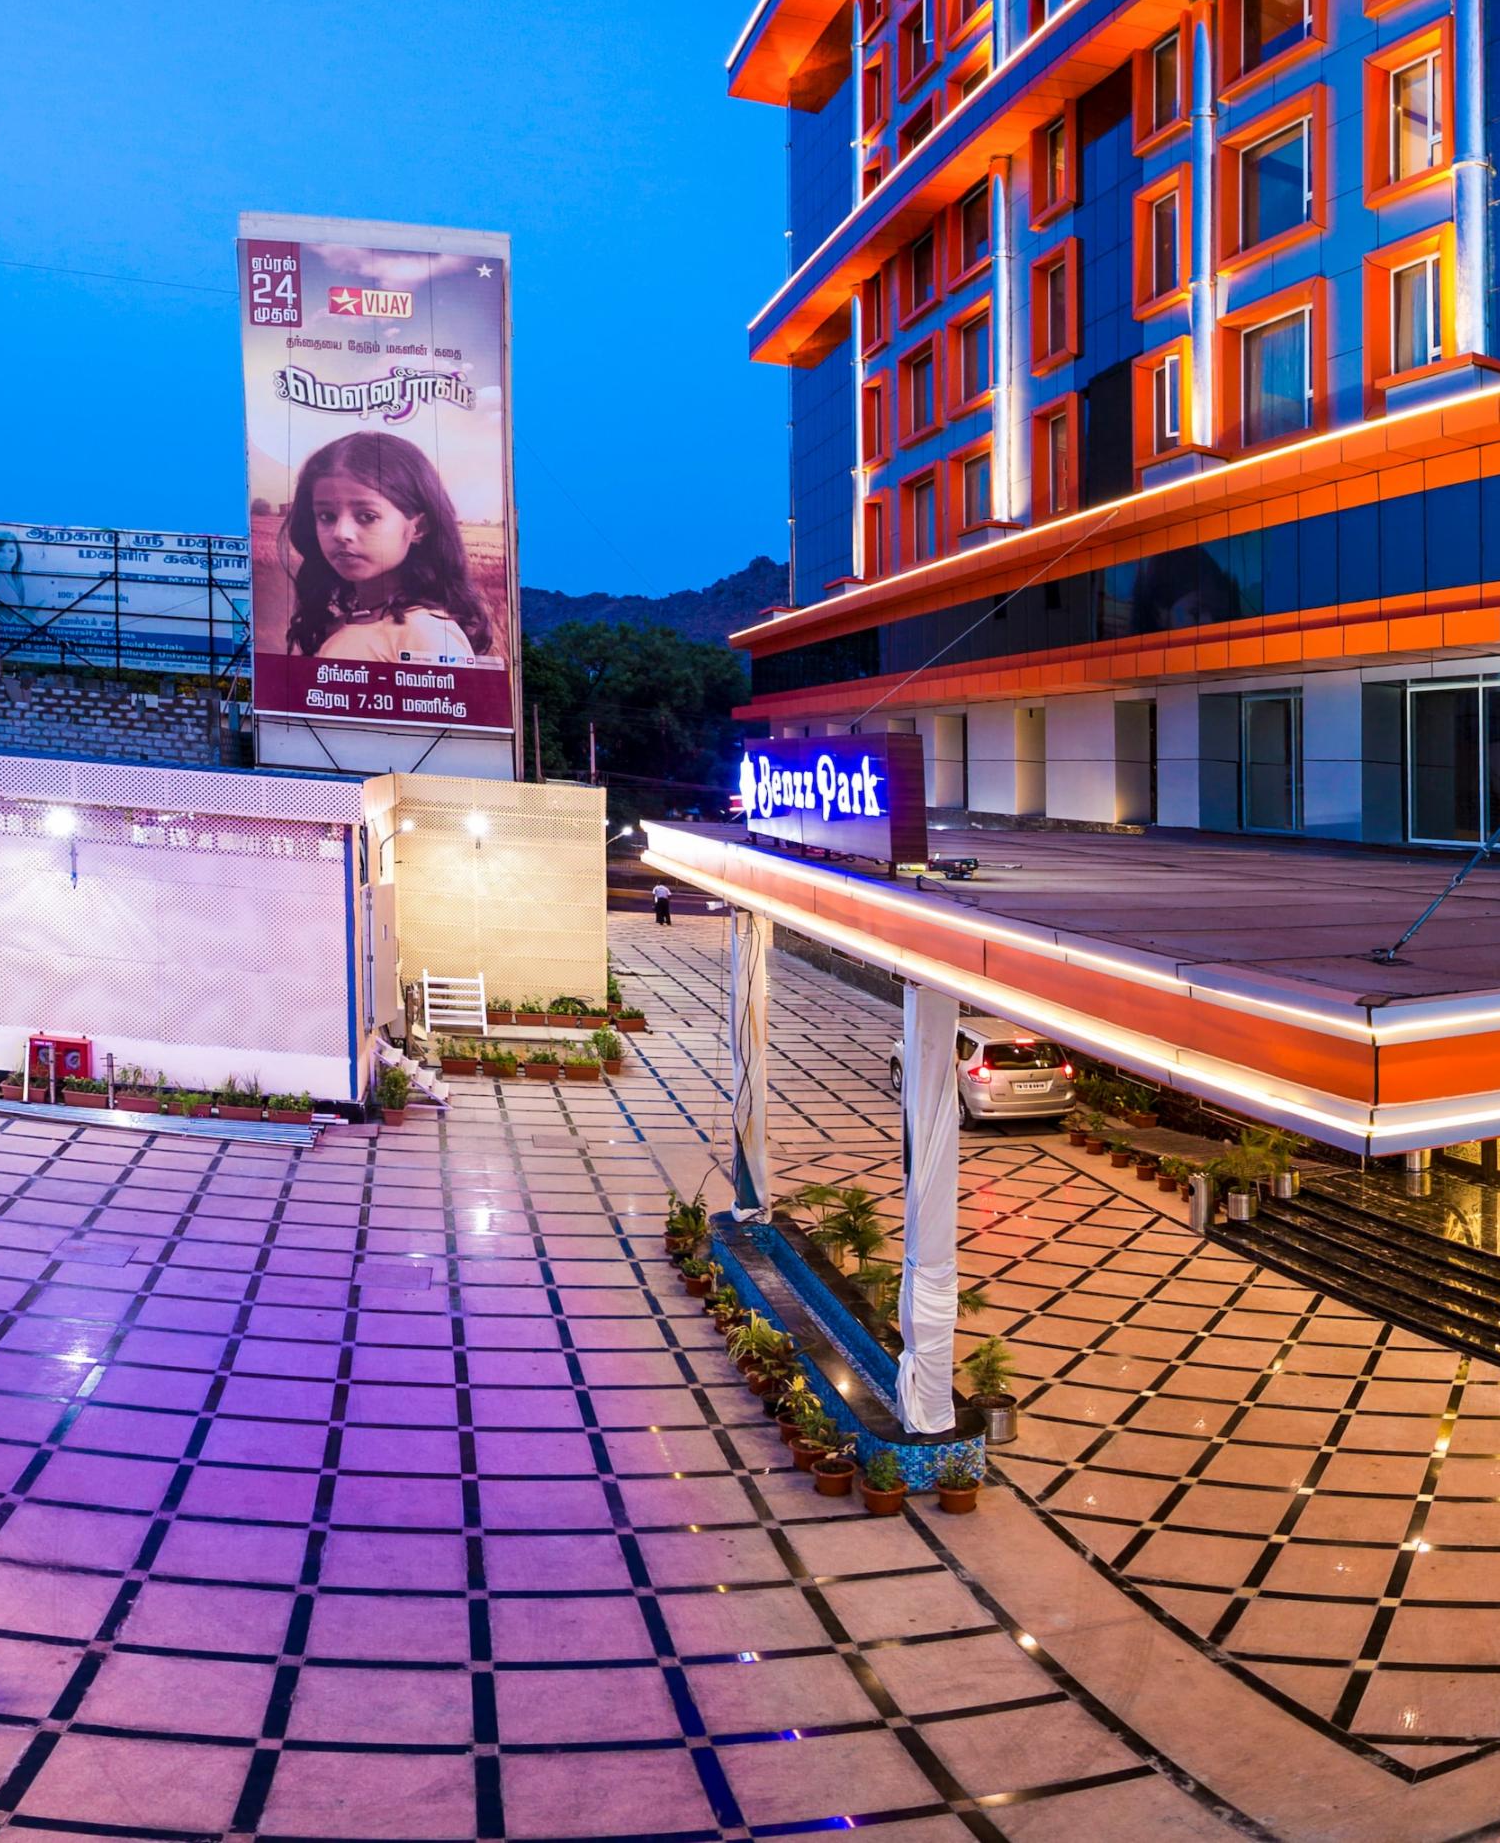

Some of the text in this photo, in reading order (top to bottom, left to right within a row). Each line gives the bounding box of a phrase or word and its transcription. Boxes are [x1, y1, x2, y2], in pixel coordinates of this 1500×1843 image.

[252, 254, 297, 273] ஏப்ரல்
[253, 273, 297, 305] 24
[254, 305, 298, 323] முதல்
[364, 292, 411, 316] VIJAY
[88, 647, 155, 658] Thirualluvar
[316, 664, 369, 684] திங்கள்
[395, 670, 455, 690] வெள்ளி
[306, 689, 467, 718] இரவு 7.30 மணிக்கு
[758, 754, 881, 822] Benzz Park
